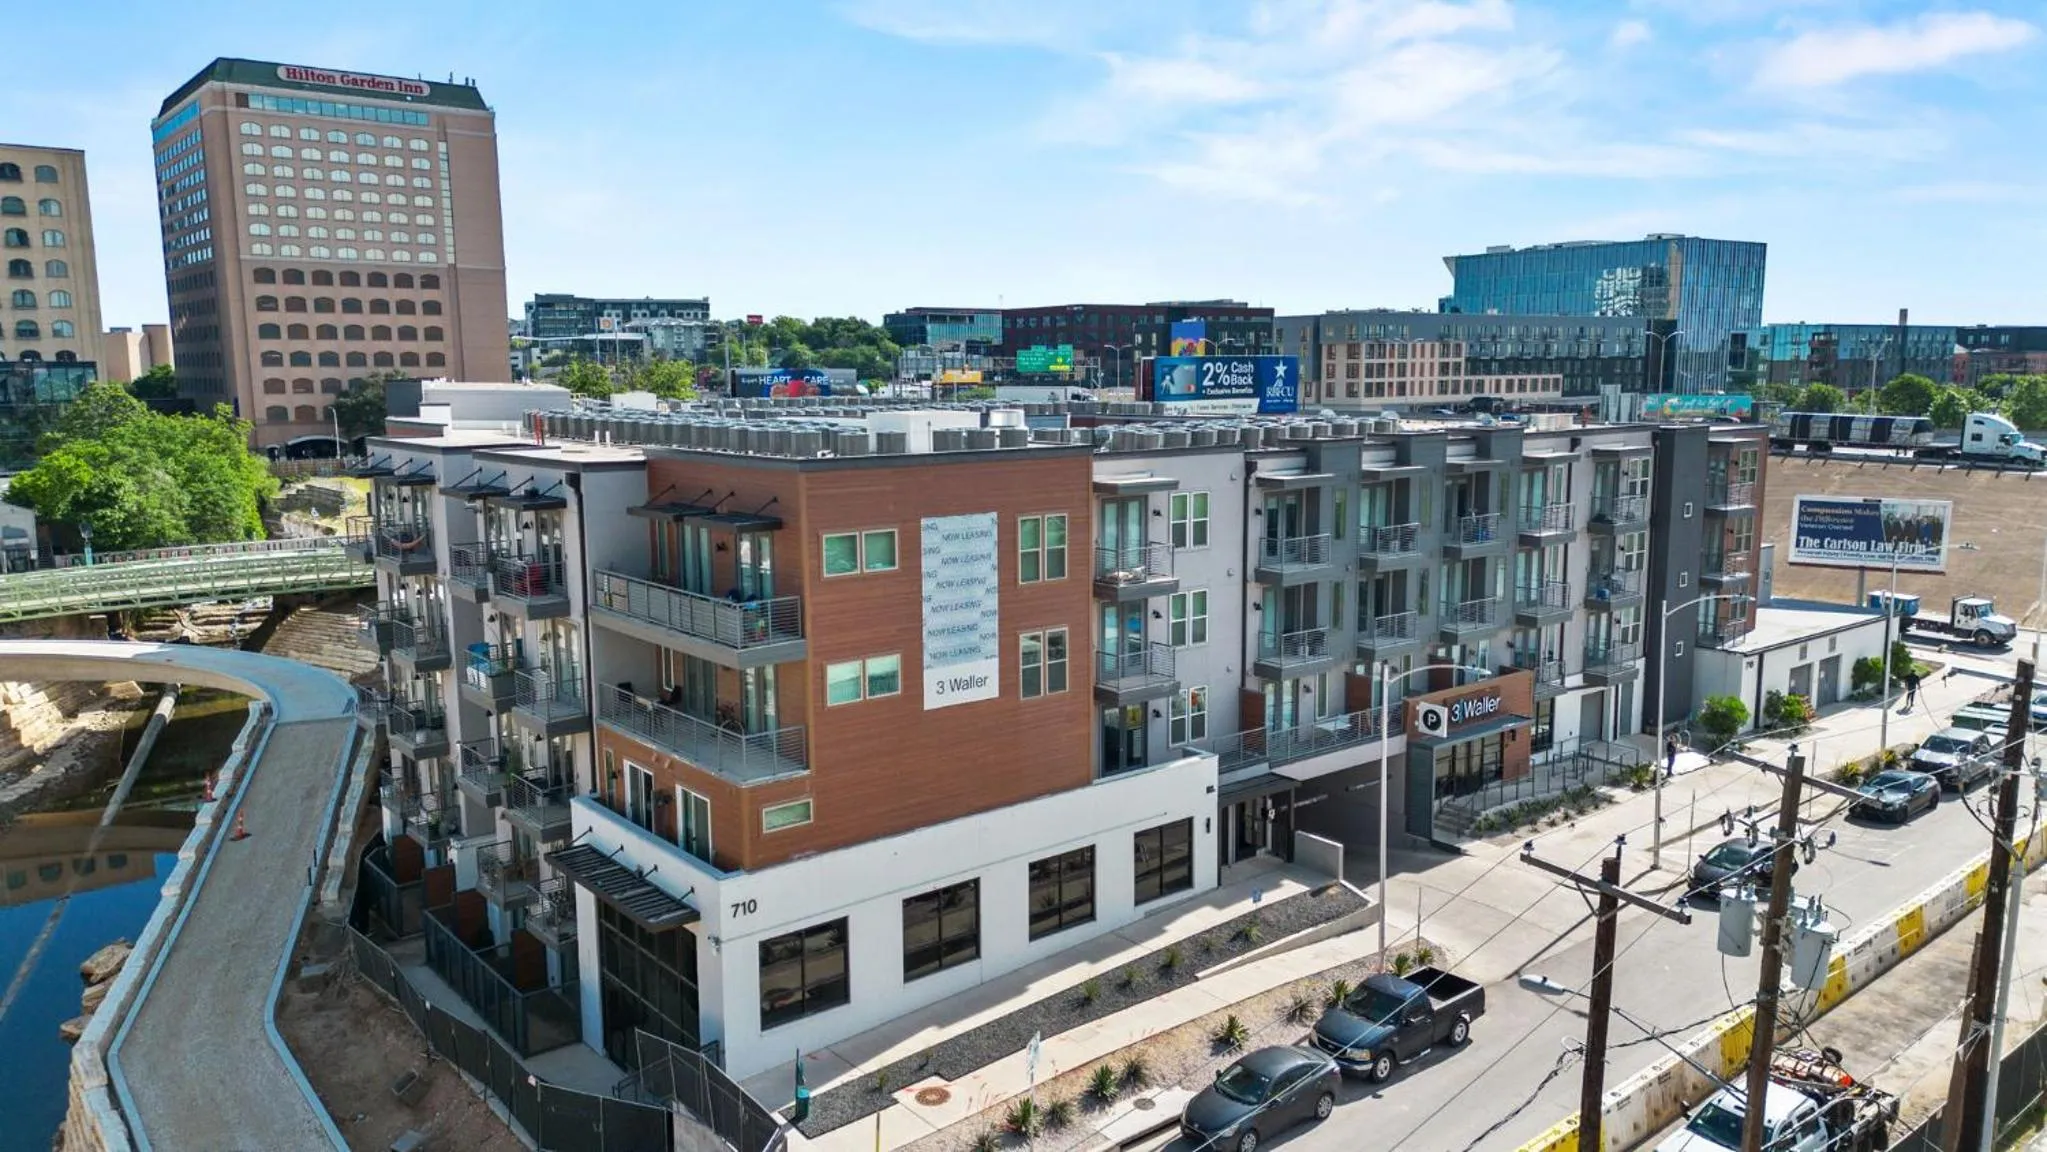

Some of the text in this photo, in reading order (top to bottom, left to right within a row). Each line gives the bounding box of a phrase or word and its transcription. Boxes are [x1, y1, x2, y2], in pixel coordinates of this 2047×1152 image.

[285, 67, 424, 95] Hilton Garden Inn
[759, 375, 792, 386] HEART
[803, 375, 829, 386] CARE
[1202, 361, 1254, 387] 2% Cash
[1231, 374, 1254, 385] Back
[1799, 535, 1927, 556] The Carlson Law Firm
[941, 556, 959, 566] NOW
[936, 675, 988, 695] 3 Waller
[1451, 696, 1501, 722] 3 Waller
[1427, 713, 1437, 726] P
[731, 898, 757, 919] 710
